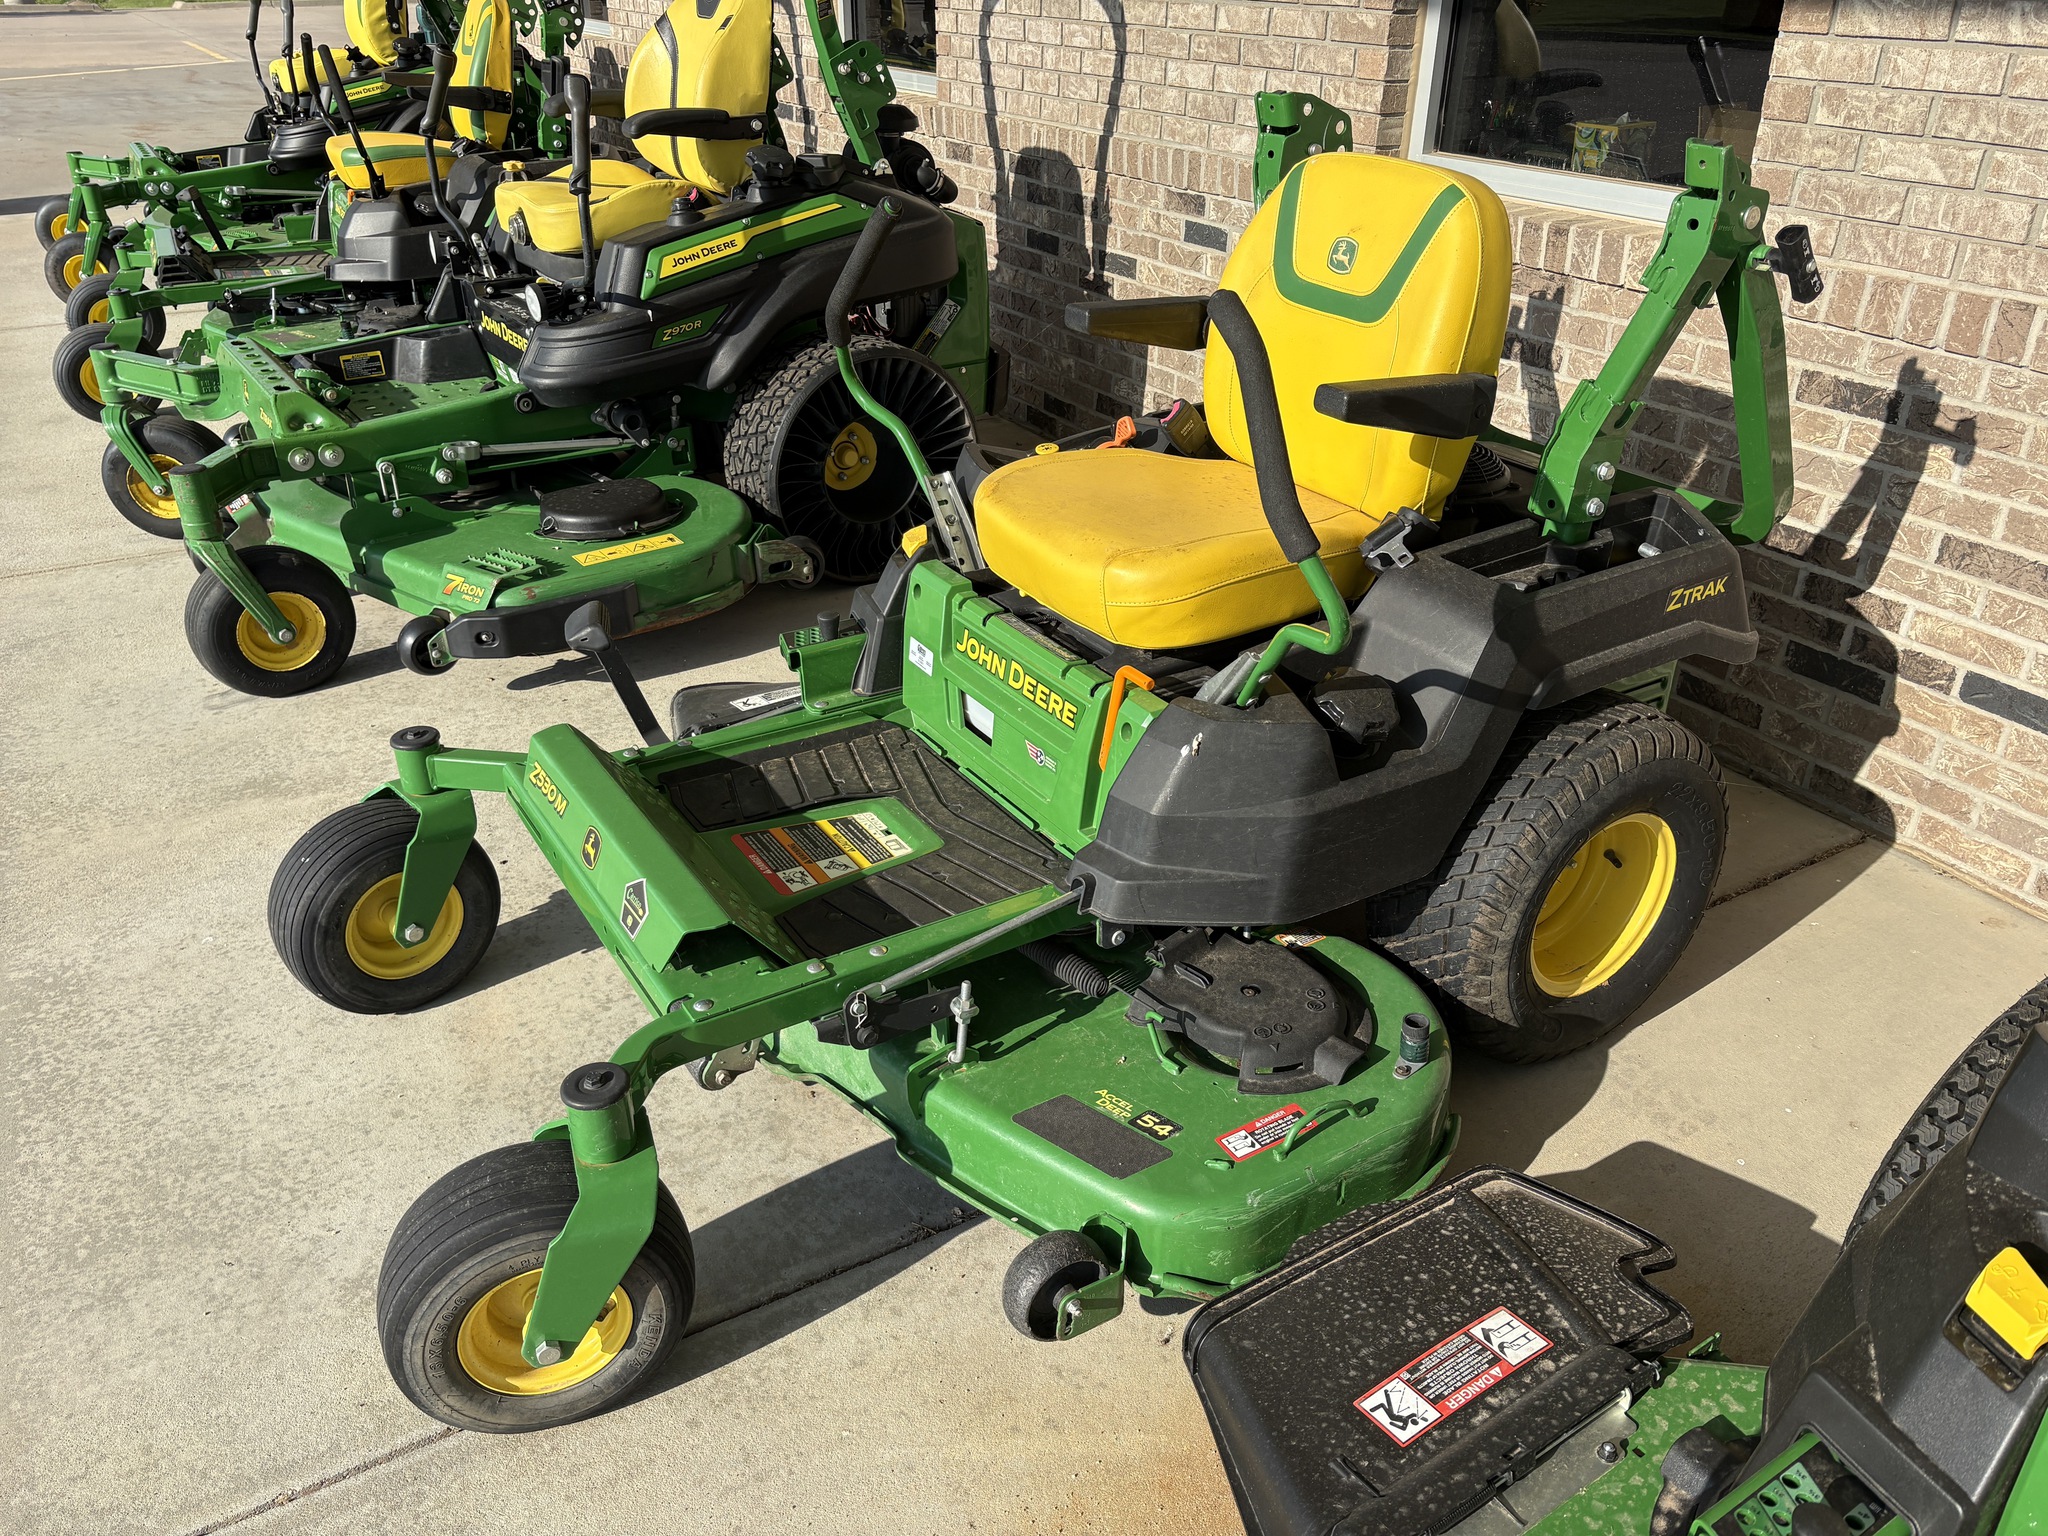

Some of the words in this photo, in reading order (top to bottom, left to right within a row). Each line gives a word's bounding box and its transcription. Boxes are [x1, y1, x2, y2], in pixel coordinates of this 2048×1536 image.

[363, 84, 385, 94] DEERE
[671, 253, 700, 268] JOHN
[701, 239, 738, 258] DEERE
[481, 311, 501, 338] JOHN
[662, 320, 702, 341] Z970R
[462, 594, 473, 602] PRO
[1666, 575, 1729, 612] ZTRAK
[956, 628, 1007, 680] JOHN
[1008, 660, 1078, 729] DEERE
[1094, 1089, 1134, 1112] ACCEL
[1095, 1098, 1132, 1119] DEEP
[1136, 1114, 1174, 1137] 54
[1254, 1121, 1278, 1134] ROTATING
[1277, 1114, 1293, 1123] BLADE
[1260, 1110, 1286, 1125] DANGER
[520, 1256, 540, 1266] PLY
[1453, 1352, 1478, 1370] THROWN
[1428, 1368, 1455, 1387] OBJECTS
[1460, 1362, 1489, 1383] ROTATING
[1441, 1381, 1462, 1396] BLADE
[1444, 1373, 1494, 1409] DANGER
